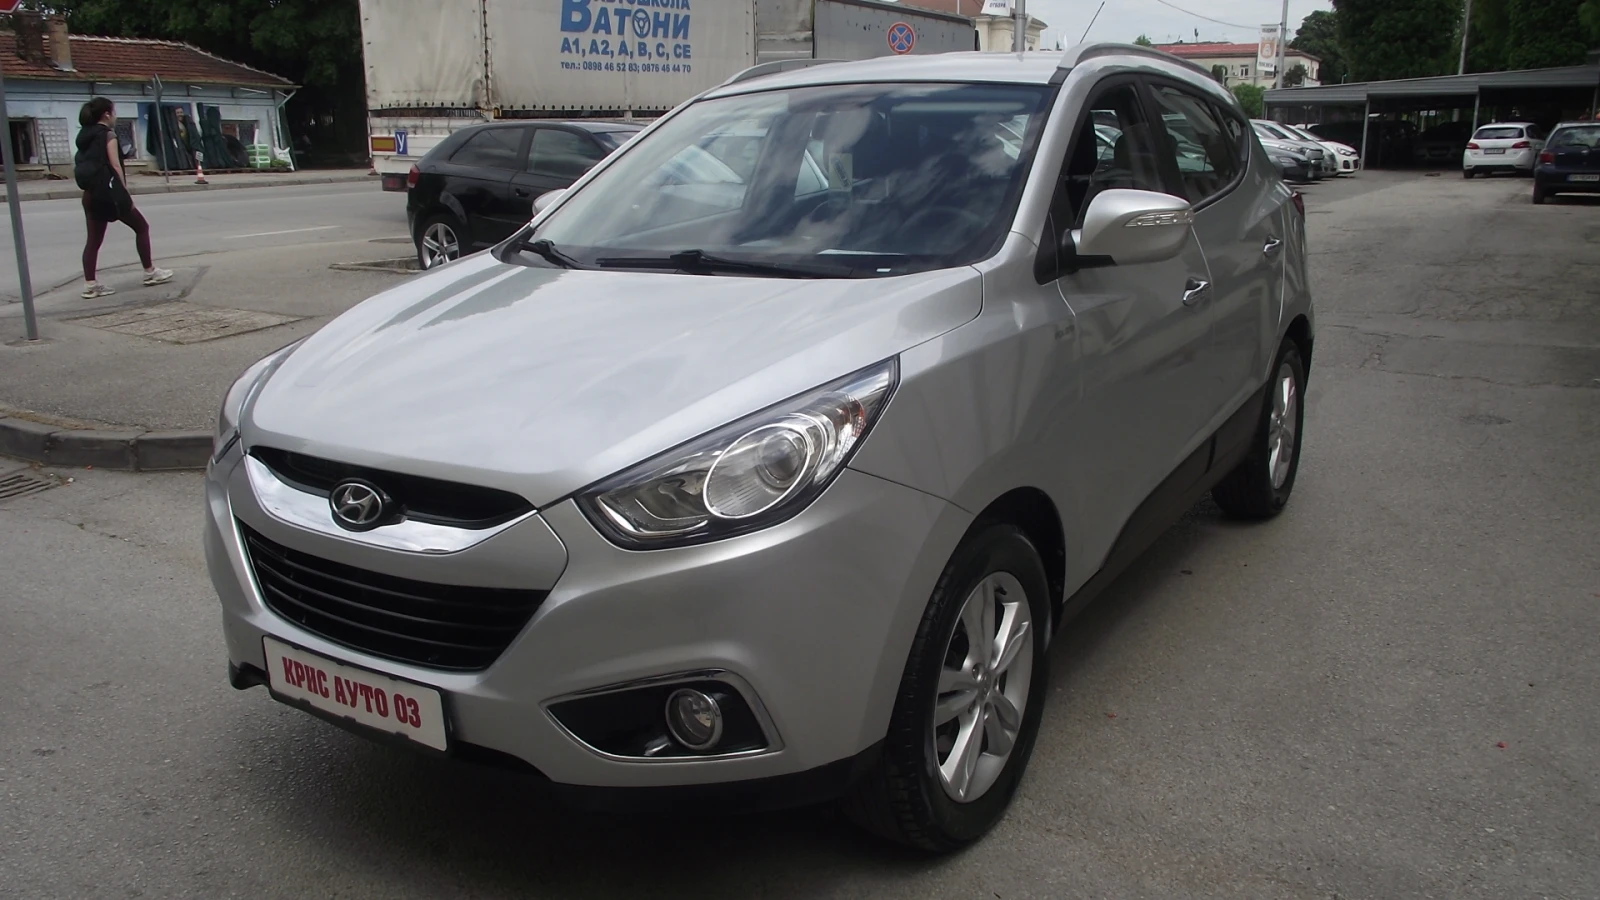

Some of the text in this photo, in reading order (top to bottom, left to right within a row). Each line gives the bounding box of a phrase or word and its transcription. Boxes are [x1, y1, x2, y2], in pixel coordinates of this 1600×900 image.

[560, 37, 586, 58] A1,
[588, 39, 615, 59] A2,
[673, 43, 691, 59] CE
[582, 60, 603, 71] 0898
[604, 62, 615, 72] 46
[616, 62, 627, 72] 52
[641, 63, 660, 73] 0876
[672, 64, 681, 73] 44
[682, 64, 691, 74] 70
[281, 656, 422, 728] КРИС АУТО 03
